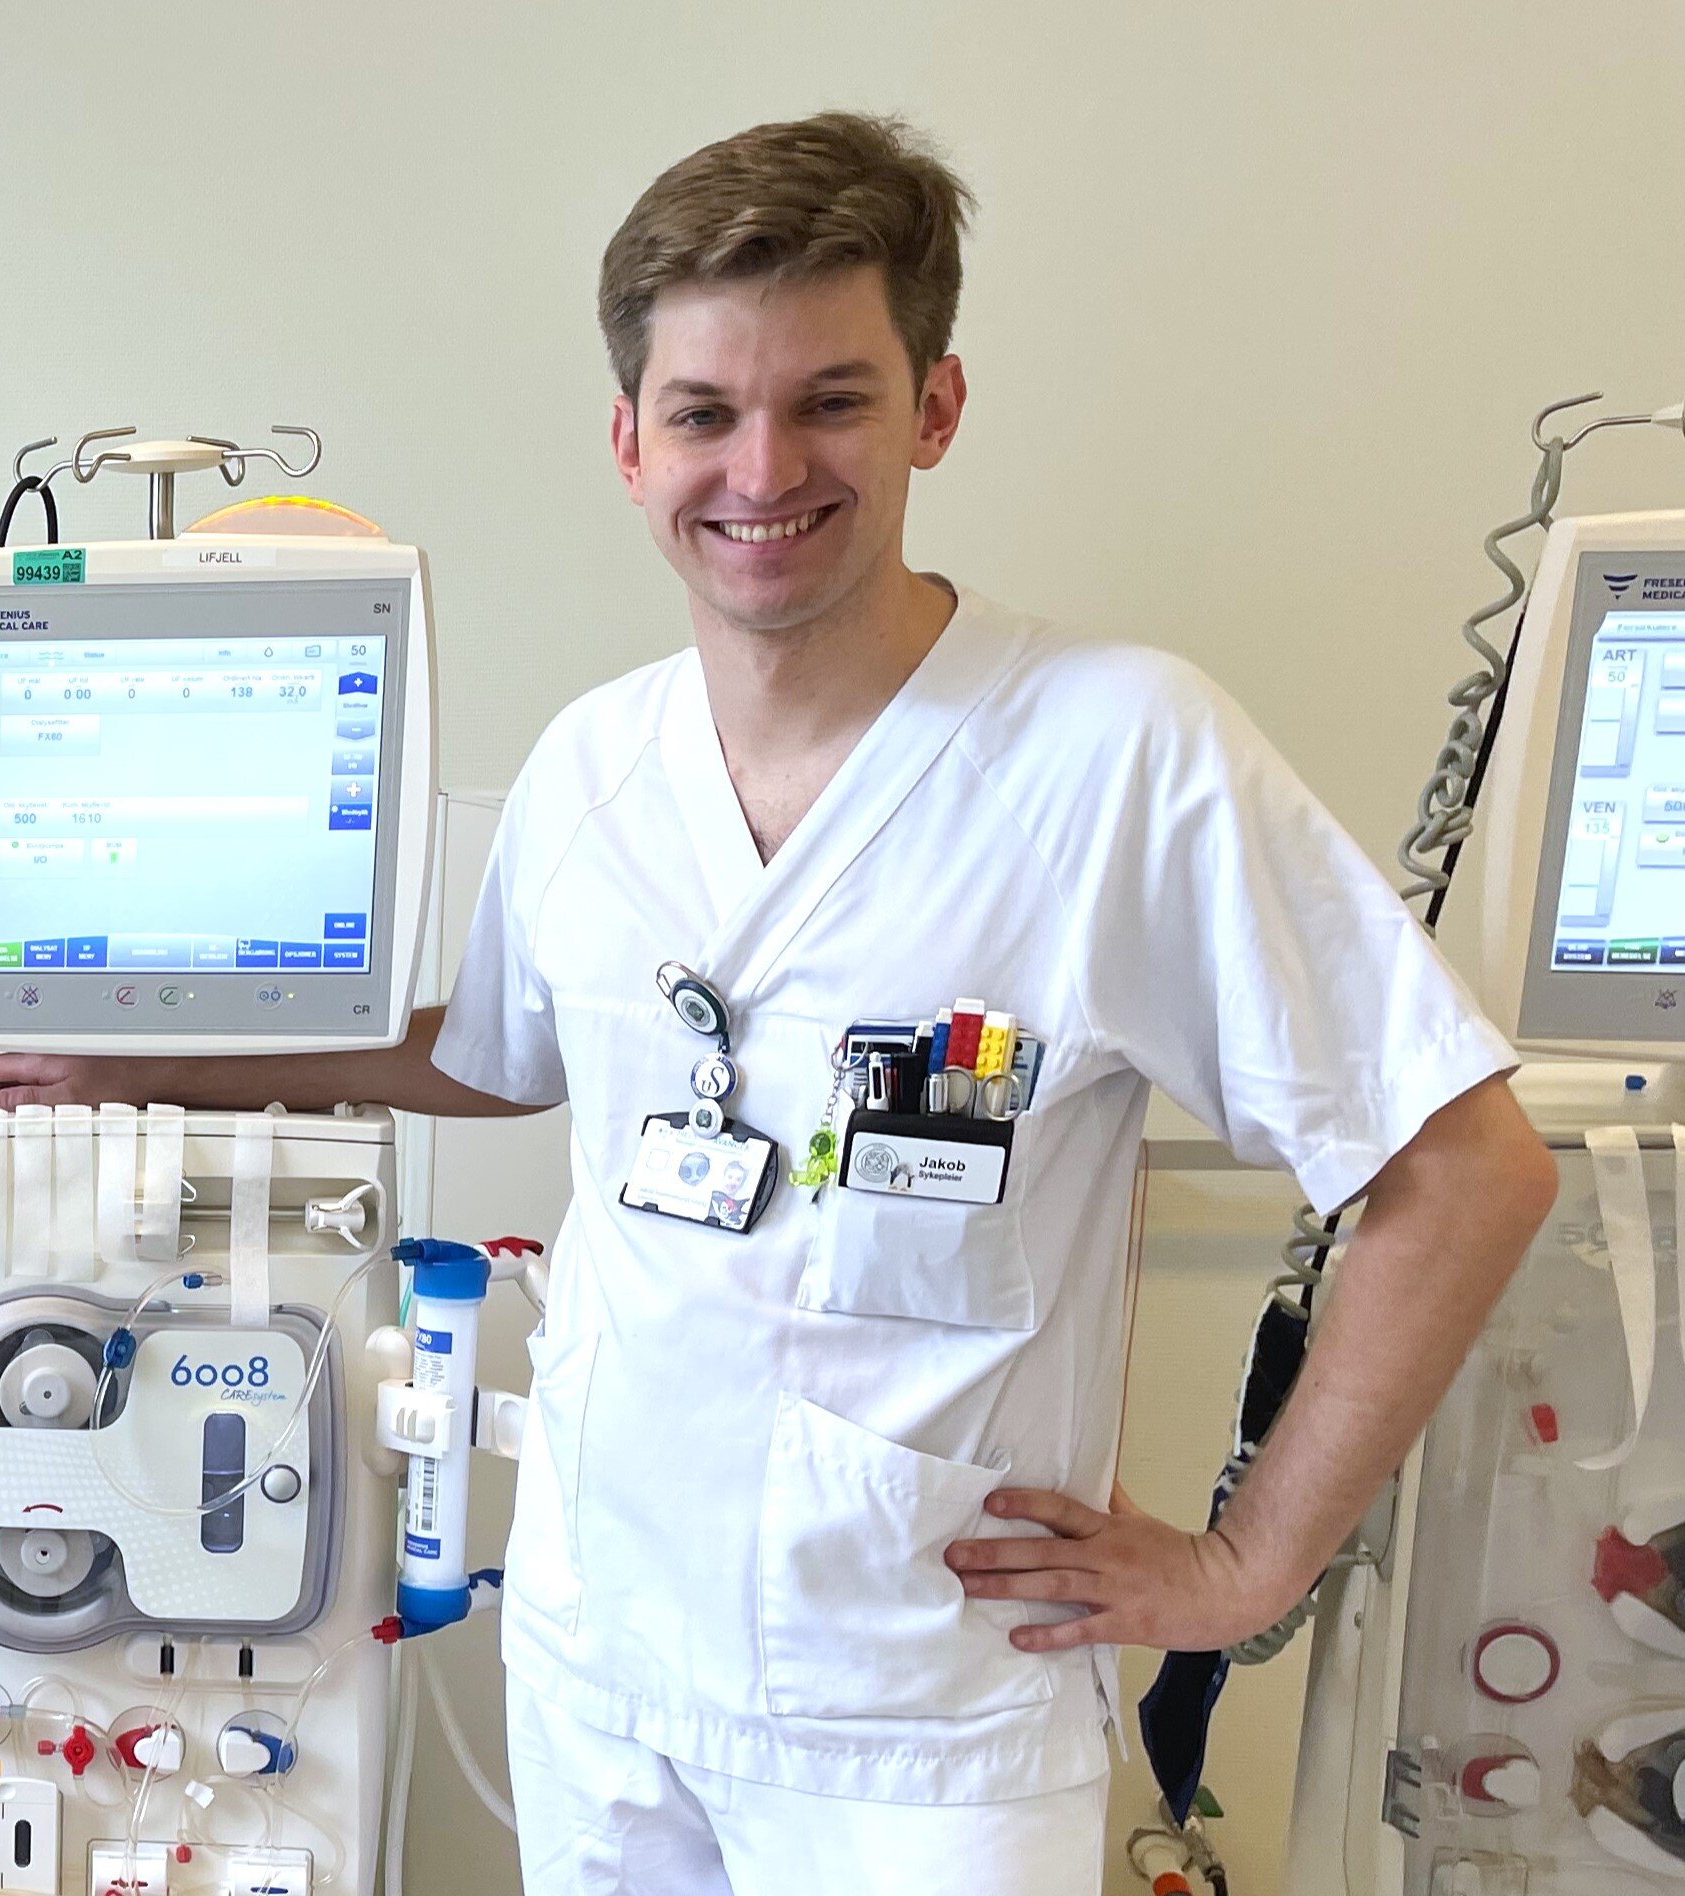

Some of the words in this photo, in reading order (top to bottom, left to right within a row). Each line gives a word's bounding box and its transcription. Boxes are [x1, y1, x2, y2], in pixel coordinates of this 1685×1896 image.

[62, 550, 83, 560] A2
[199, 552, 243, 563] LIFJELL
[17, 566, 61, 581] 99439
[1642, 590, 1685, 600] MEDICA
[373, 603, 391, 614] SN
[21, 621, 49, 631] CARE
[351, 645, 367, 656] 50
[1603, 649, 1637, 661] ART
[1608, 671, 1626, 682] 50
[24, 689, 32, 700] 0
[128, 688, 136, 699] 0
[182, 687, 190, 698] 0
[231, 686, 253, 698] 138
[1583, 801, 1616, 813] VEN
[14, 813, 37, 824] 500
[353, 1004, 371, 1015] CR
[919, 1156, 966, 1172] Jakob
[918, 1170, 963, 1182] Sykepleier
[171, 1354, 269, 1387] 6008
[220, 1388, 288, 1407] CAREsystem
